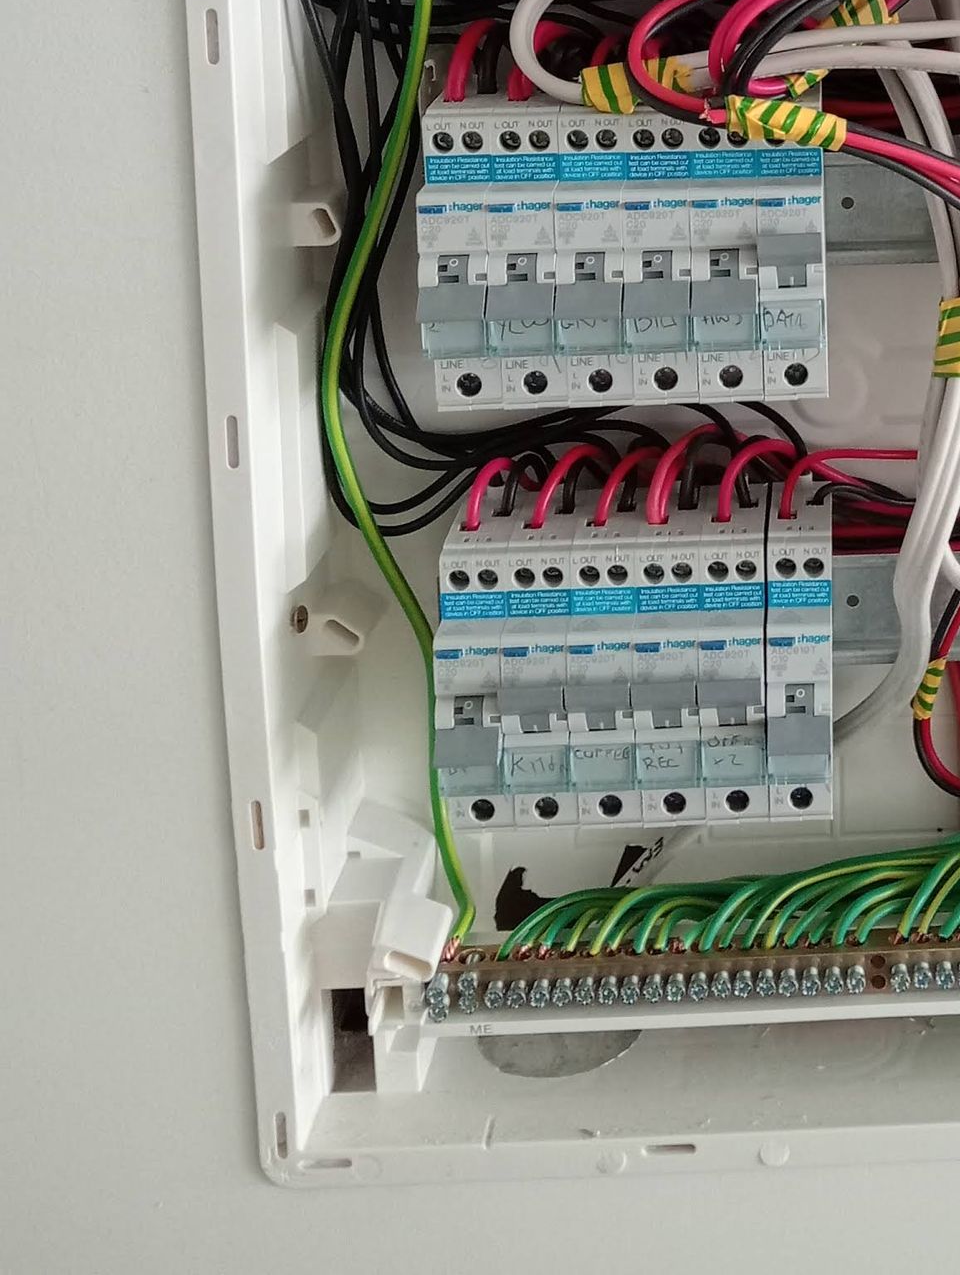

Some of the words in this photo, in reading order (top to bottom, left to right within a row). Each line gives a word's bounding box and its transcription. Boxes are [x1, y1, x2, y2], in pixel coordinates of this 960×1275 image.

[570, 357, 592, 365] LINE
[638, 354, 660, 363] LINE
[702, 353, 724, 362] LINE
[767, 352, 788, 361] LINE
[440, 361, 463, 369] LINE
[506, 360, 528, 369] LINE
[470, 1024, 492, 1035] ME
